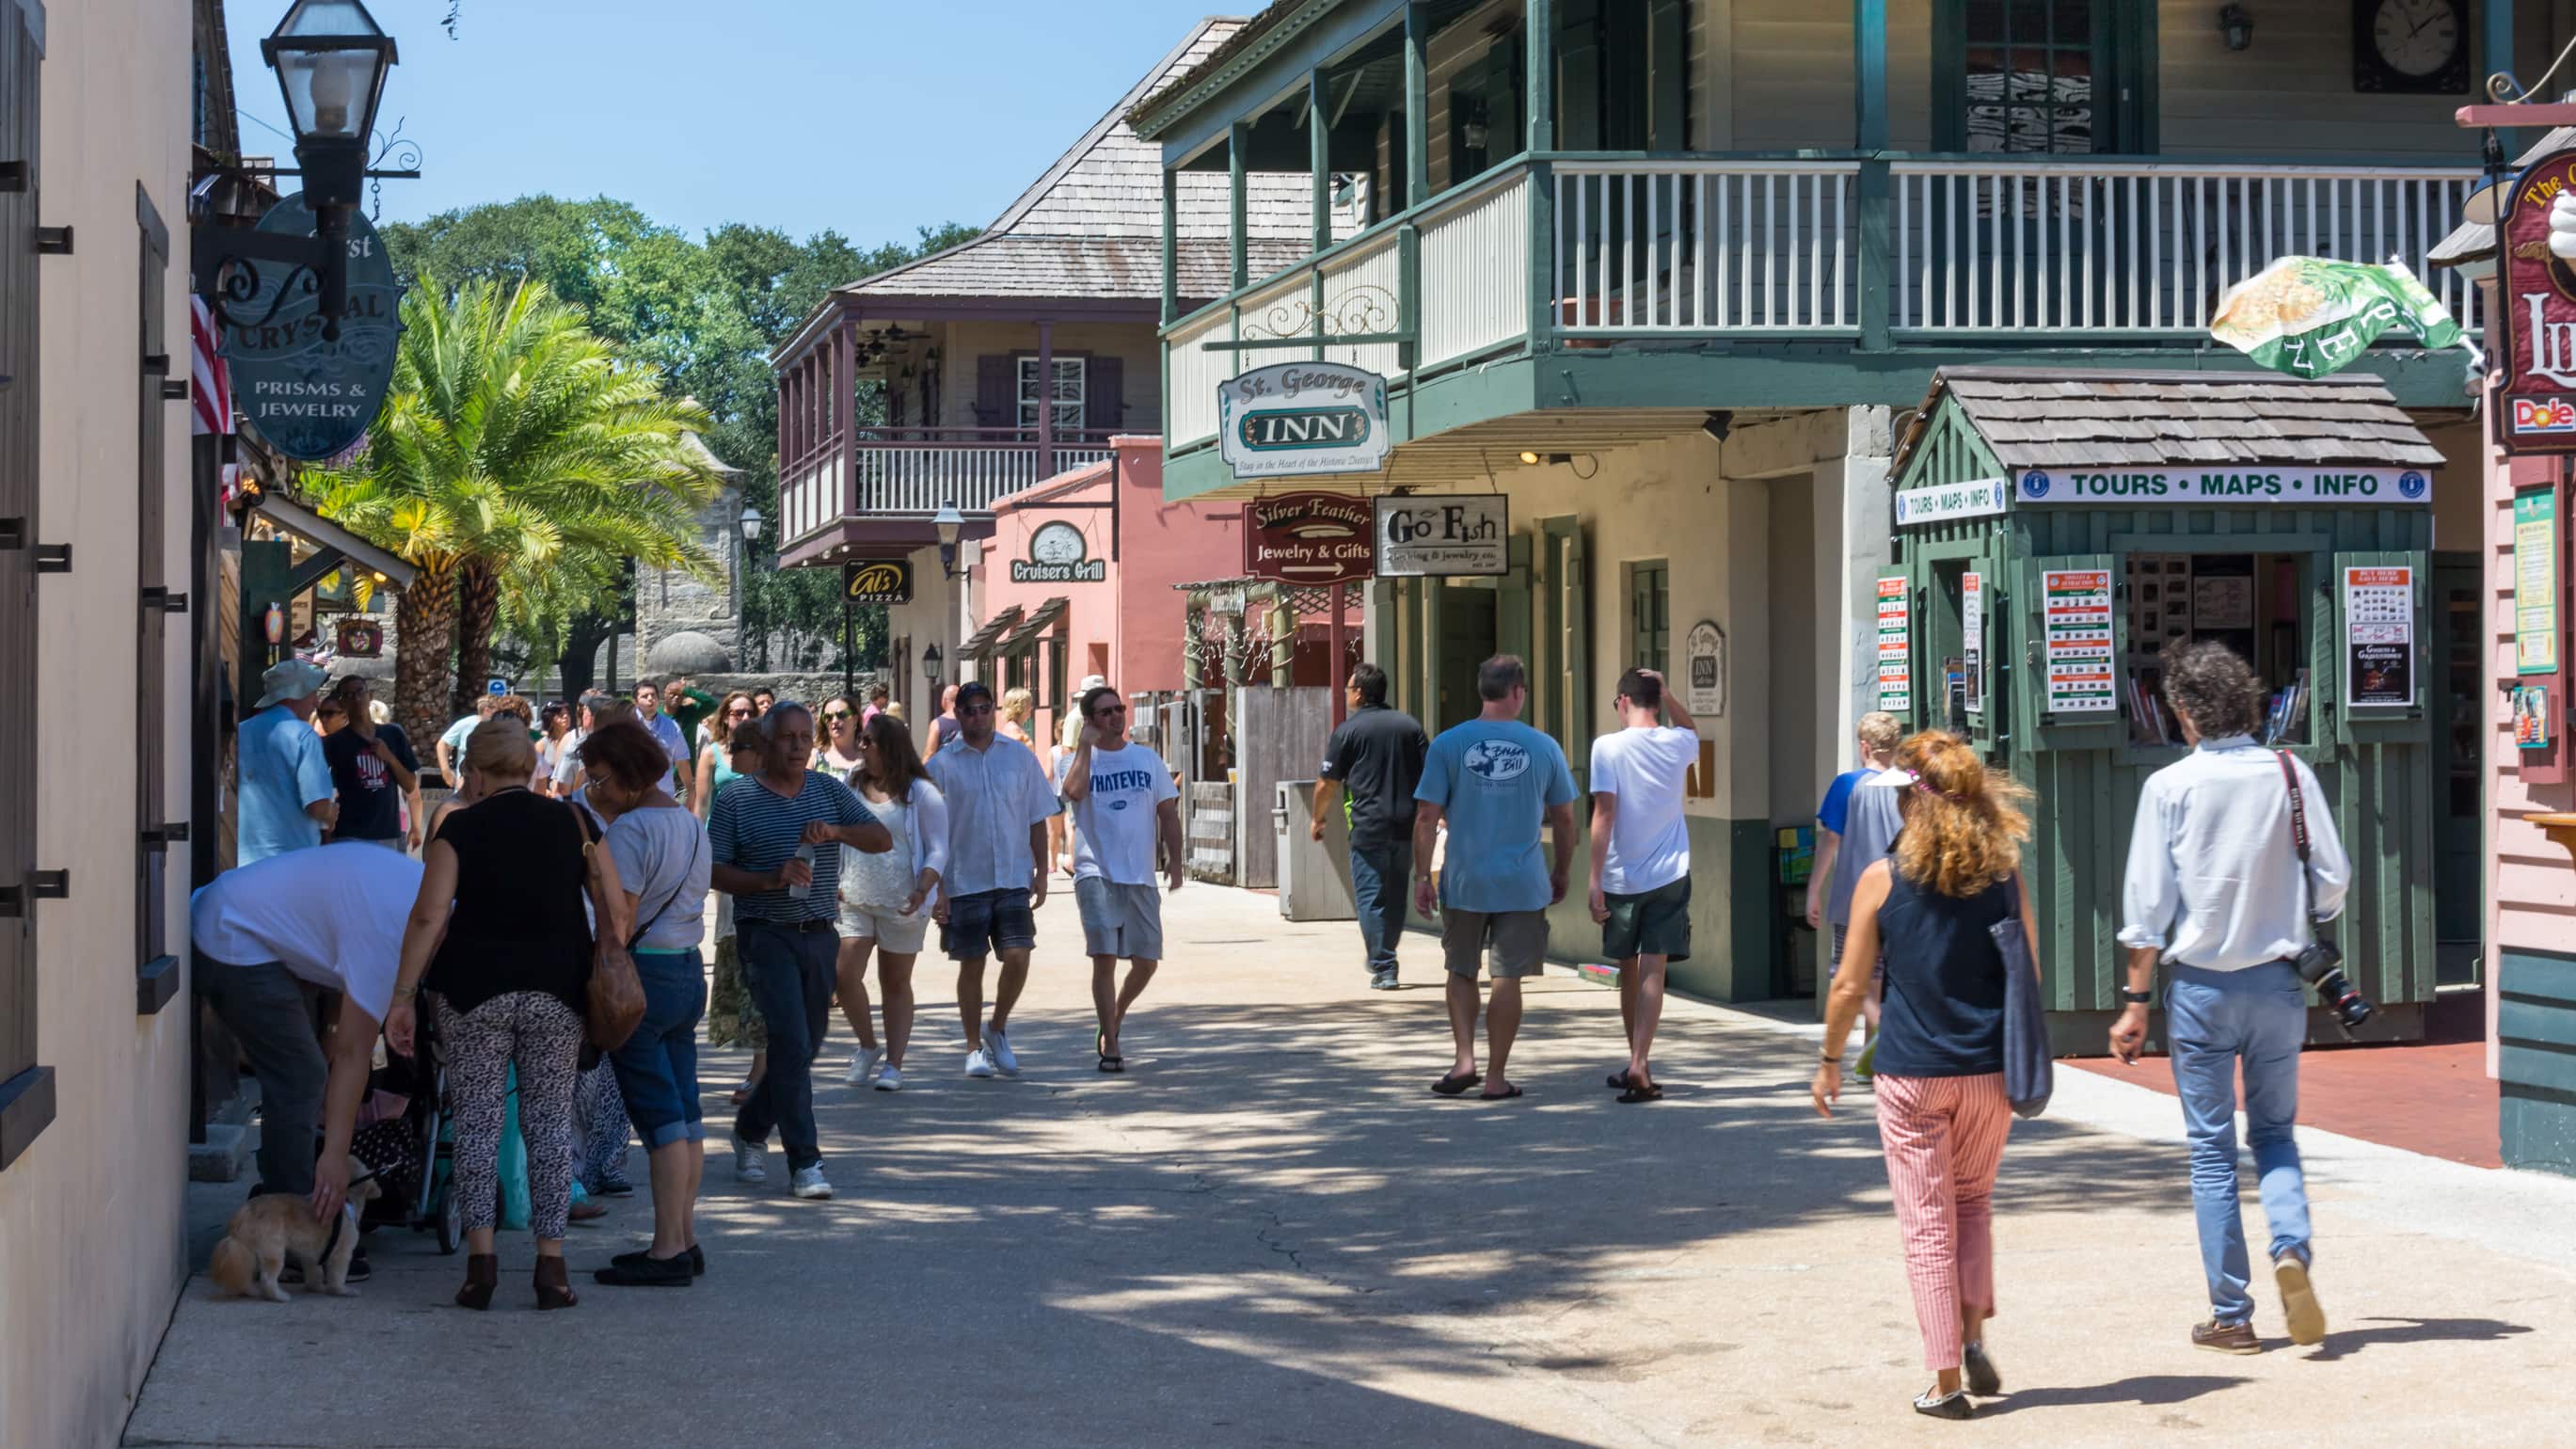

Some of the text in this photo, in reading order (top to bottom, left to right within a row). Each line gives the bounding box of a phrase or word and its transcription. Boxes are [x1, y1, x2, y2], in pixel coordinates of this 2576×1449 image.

[2523, 176, 2562, 208] The
[239, 295, 385, 349] CRYSAL
[255, 381, 366, 397] PRISMS &
[1239, 368, 1367, 405] St. George
[259, 403, 361, 418] JEWELRY
[2516, 399, 2574, 428] Dole
[1260, 413, 1351, 443] INN
[2070, 473, 2378, 496] TOURS MAPS INFO
[1255, 498, 1371, 530] Silver Feather
[1910, 488, 1990, 515] TOURS MAPS INFO
[1388, 506, 1496, 543] Go Fish
[1257, 543, 1371, 564] Jewelry & Gifts
[1013, 562, 1104, 580] Cruisers Grill
[1694, 661, 1712, 676] INN
[1501, 757, 1522, 772] Bill
